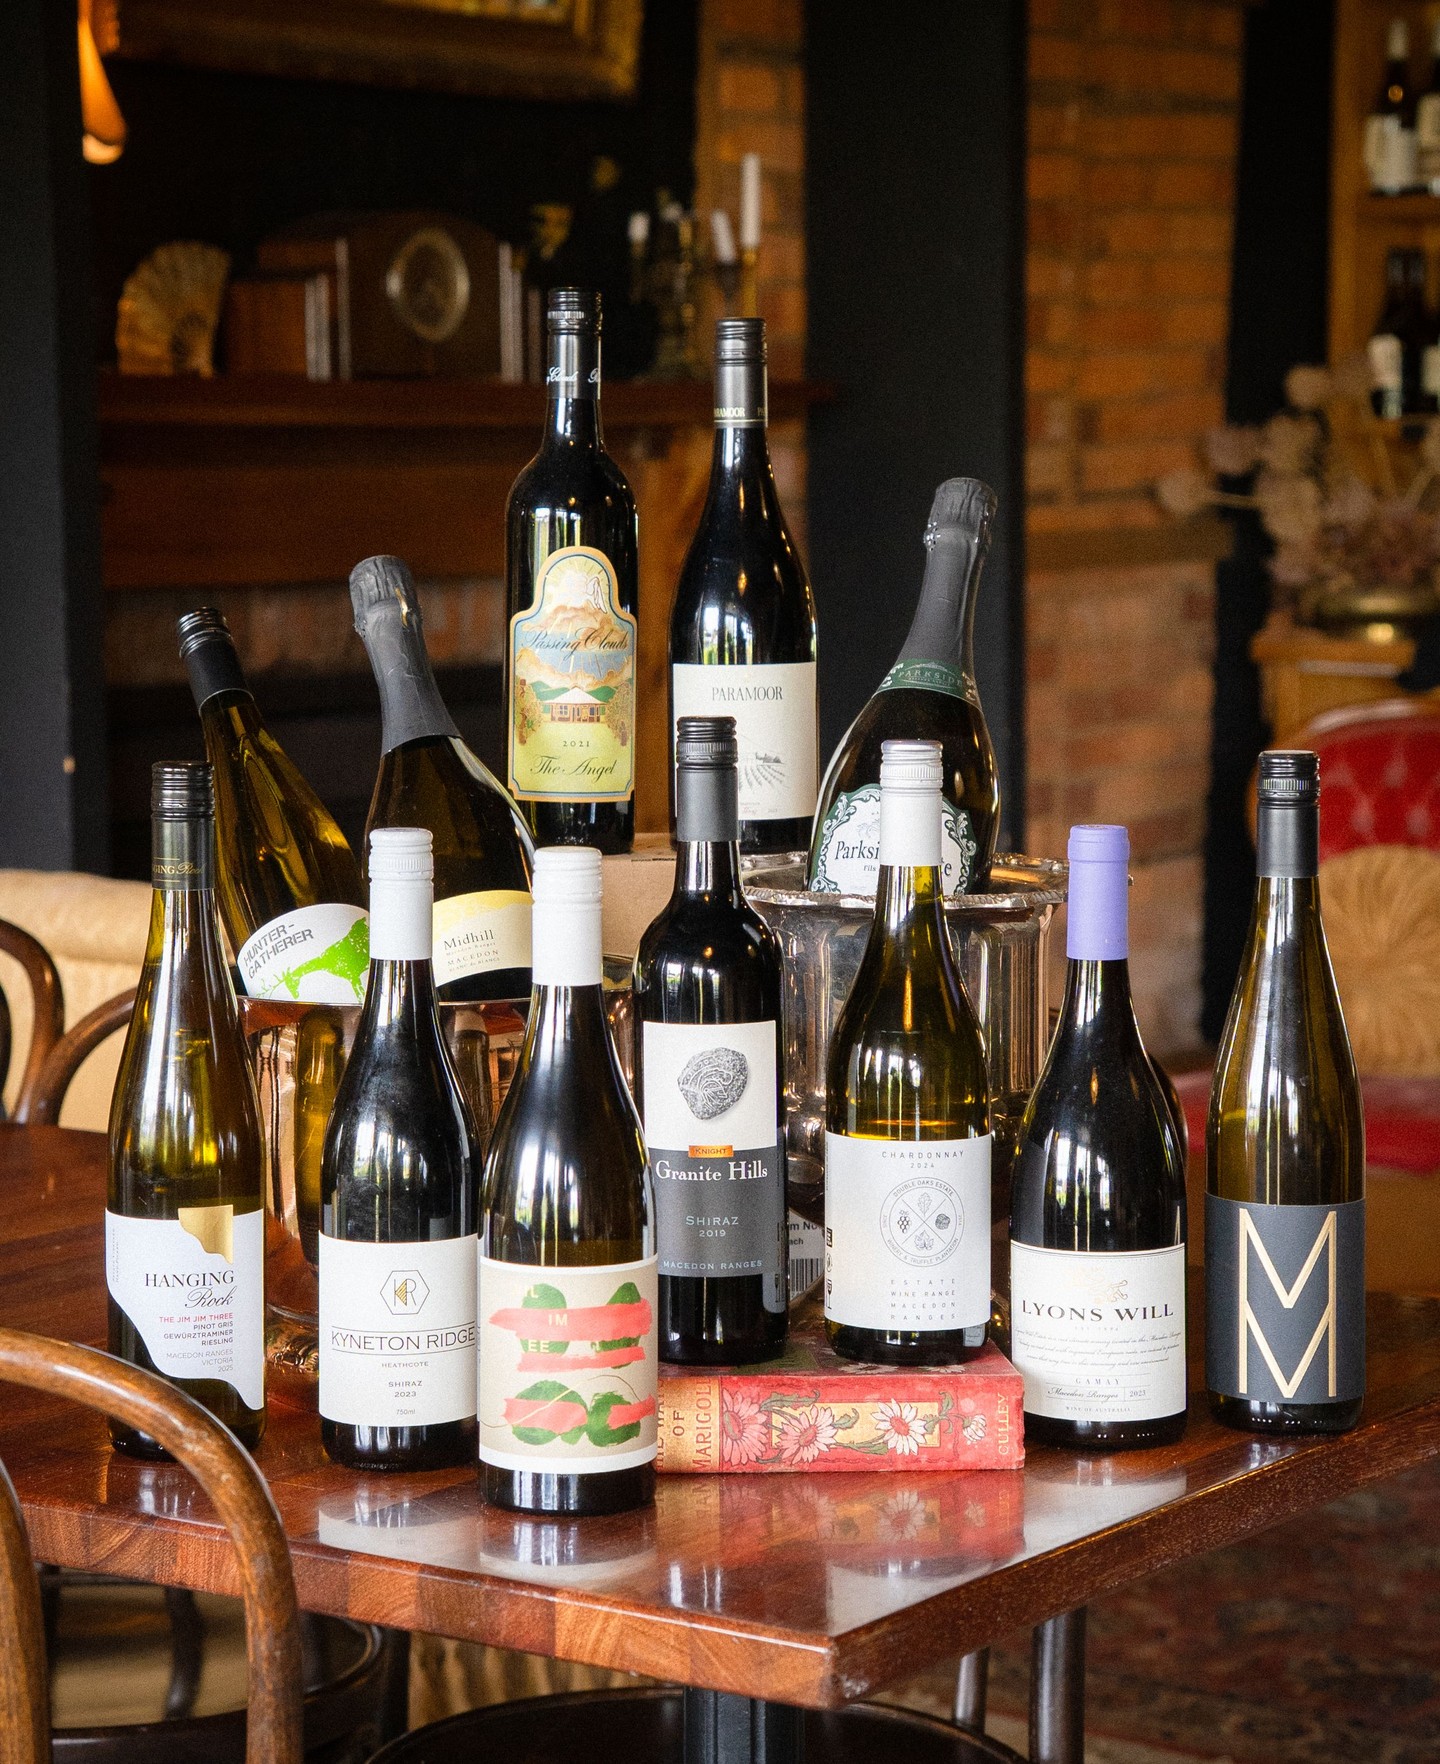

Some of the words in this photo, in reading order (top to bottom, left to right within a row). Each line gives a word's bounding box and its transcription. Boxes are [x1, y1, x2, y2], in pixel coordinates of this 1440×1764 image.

[521, 629, 582, 660] Passing
[575, 626, 629, 651] Clouds
[898, 670, 963, 686] PARKSIDE
[712, 686, 784, 701] PARAMOOR
[563, 740, 590, 748] 2021
[530, 756, 561, 776] The
[562, 756, 617, 783] Angel
[835, 840, 880, 860] Parksi
[444, 929, 494, 950] Midhill
[248, 928, 314, 979] GATHERER
[447, 950, 499, 966] MACEDON
[882, 1150, 964, 1158] CHARDONNAY
[656, 1160, 722, 1181] Granite
[729, 1160, 768, 1180] Hills
[893, 1182, 916, 1198] DOUBLE
[935, 1183, 954, 1197] ESTATE
[686, 1215, 739, 1226] SHIRAZ
[699, 1229, 726, 1237] 2019
[910, 1256, 933, 1264] TRUFFLE
[935, 1238, 959, 1261] PLANTATION
[663, 1260, 714, 1270] MACEDON
[720, 1259, 762, 1270] RANGES
[145, 1270, 234, 1288] HANGING
[891, 1278, 955, 1286] ESTATE
[185, 1286, 237, 1308] Rock
[925, 1289, 955, 1297] RANGE
[209, 1313, 233, 1321] THREE
[1022, 1300, 1103, 1322] LYONS
[1115, 1303, 1174, 1321] WILL
[164, 1330, 233, 1339] GEWÜRZTRAMINER
[201, 1337, 233, 1346] RIESLING
[332, 1331, 420, 1351] KYNETON
[427, 1326, 475, 1349] RIDGE
[166, 1351, 204, 1359] MACEDON
[205, 1349, 233, 1357] RANGES
[528, 1340, 550, 1352] EE
[202, 1358, 233, 1366] VICTORIA
[1048, 1386, 1084, 1398] Macedon
[1086, 1391, 1118, 1403] Ranges
[673, 1410, 684, 1436] OF
[998, 1392, 1009, 1455] CULLEY
